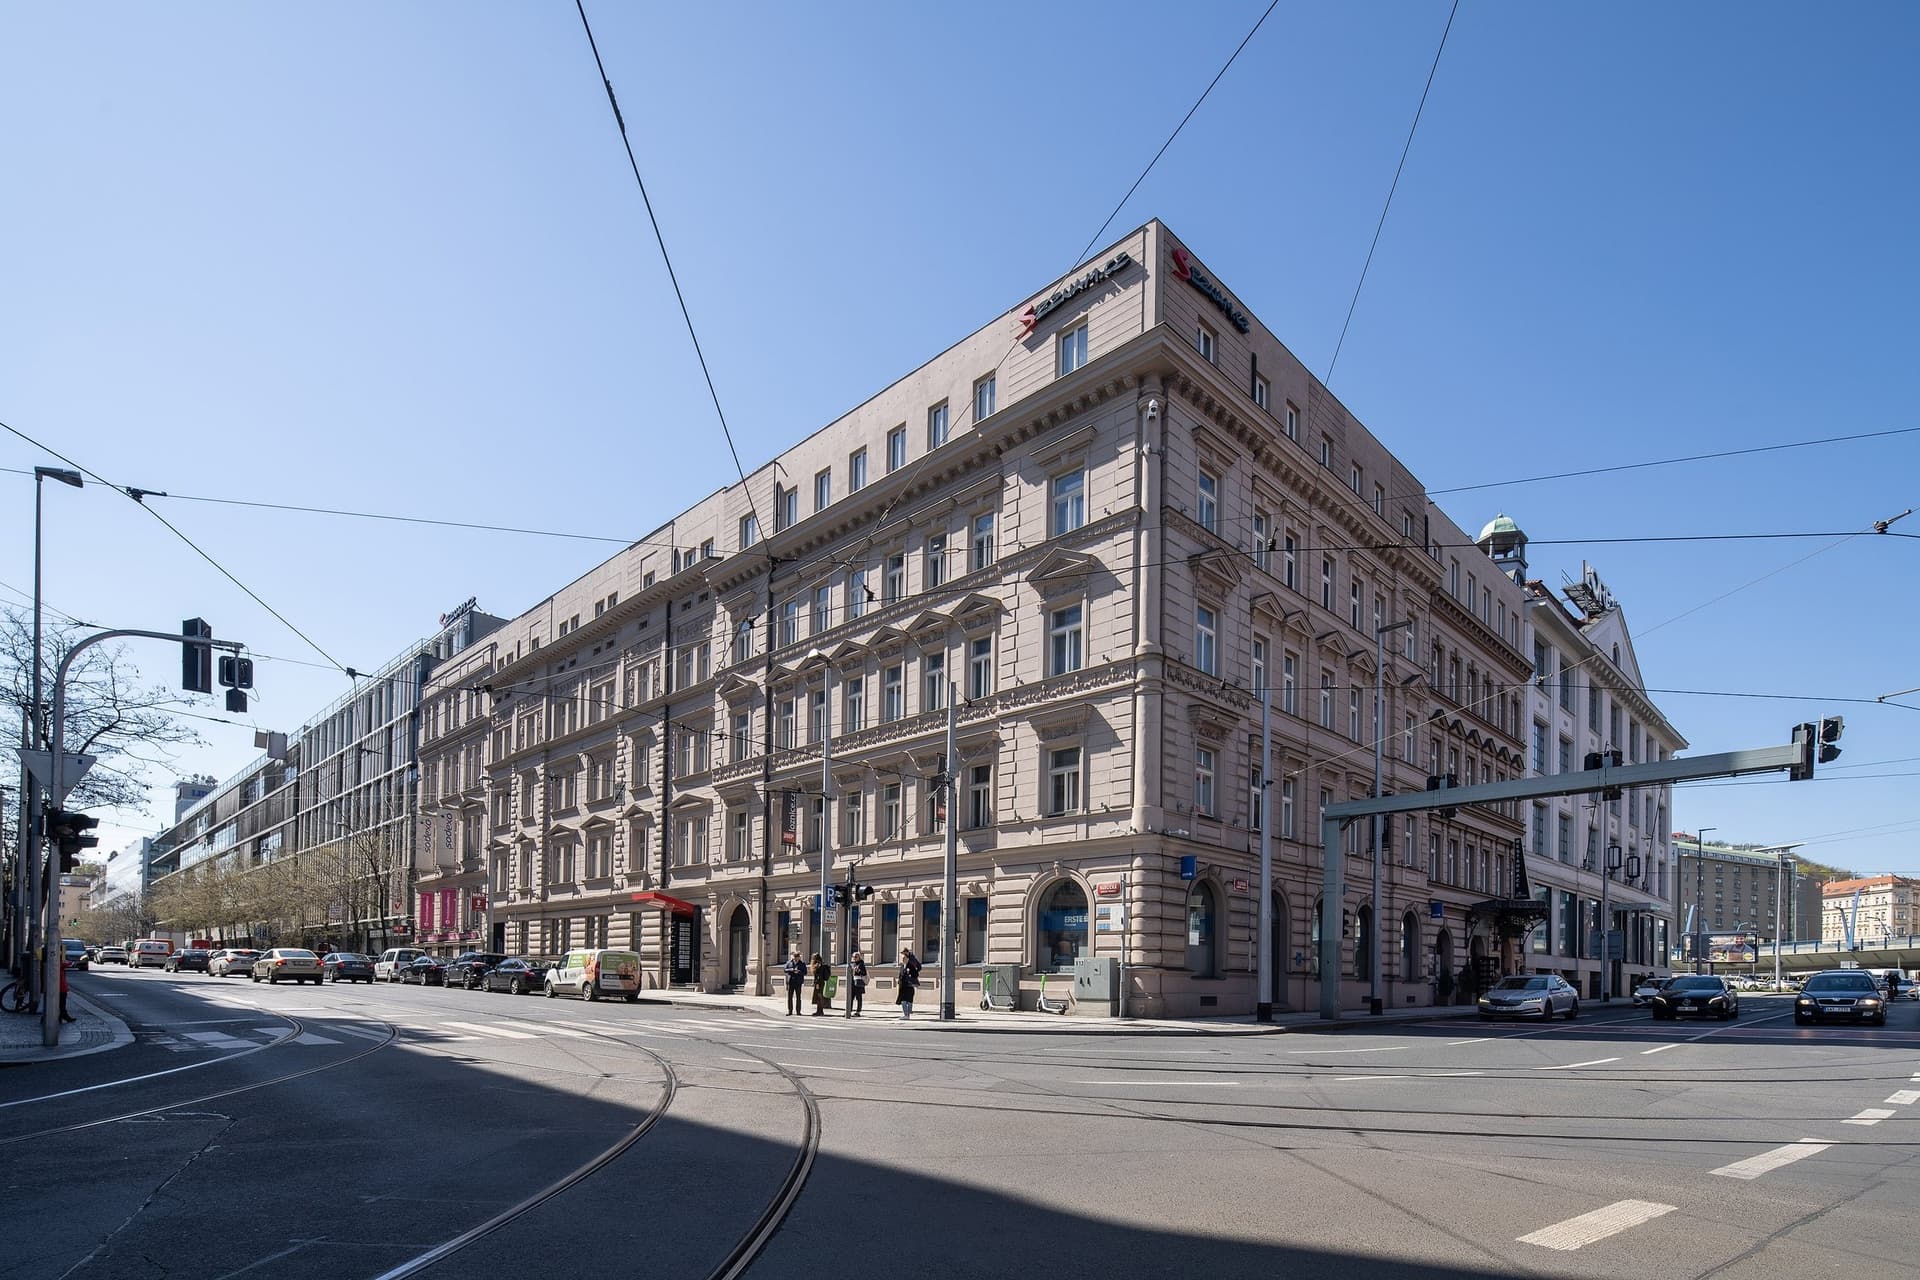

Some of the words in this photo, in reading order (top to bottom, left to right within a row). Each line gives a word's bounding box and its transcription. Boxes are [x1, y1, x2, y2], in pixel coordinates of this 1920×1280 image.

[423, 818, 432, 854] sodexo
[444, 812, 454, 850] sodexo
[827, 888, 835, 902] P
[1064, 915, 1083, 923] ERSTE
